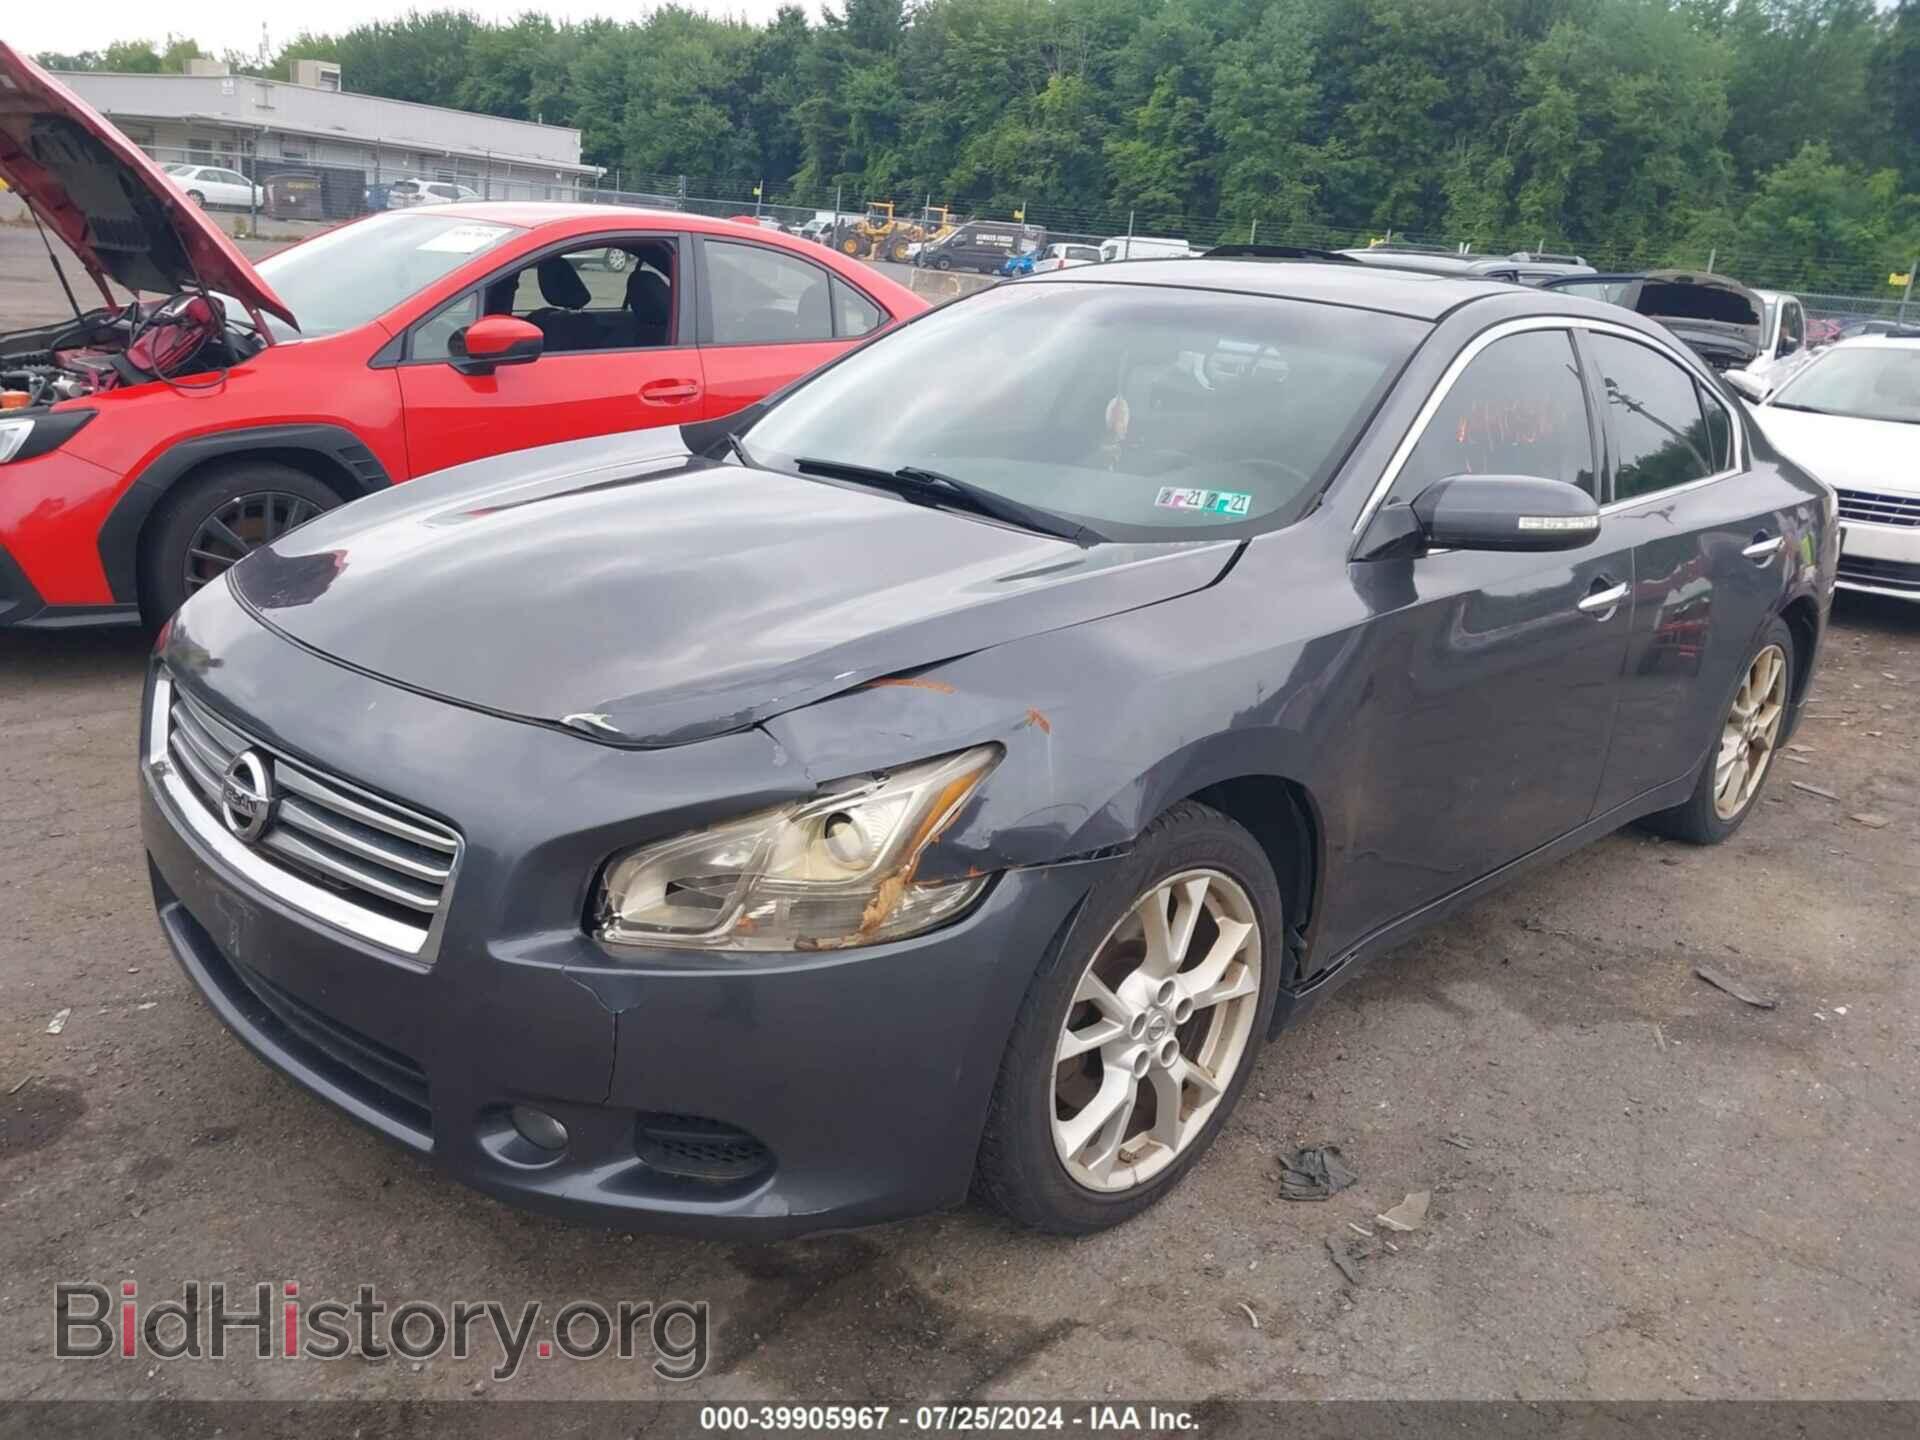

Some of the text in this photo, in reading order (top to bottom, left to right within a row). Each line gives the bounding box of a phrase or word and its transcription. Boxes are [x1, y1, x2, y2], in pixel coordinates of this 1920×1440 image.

[1186, 490, 1201, 506] 21
[1206, 493, 1247, 512] 2 21
